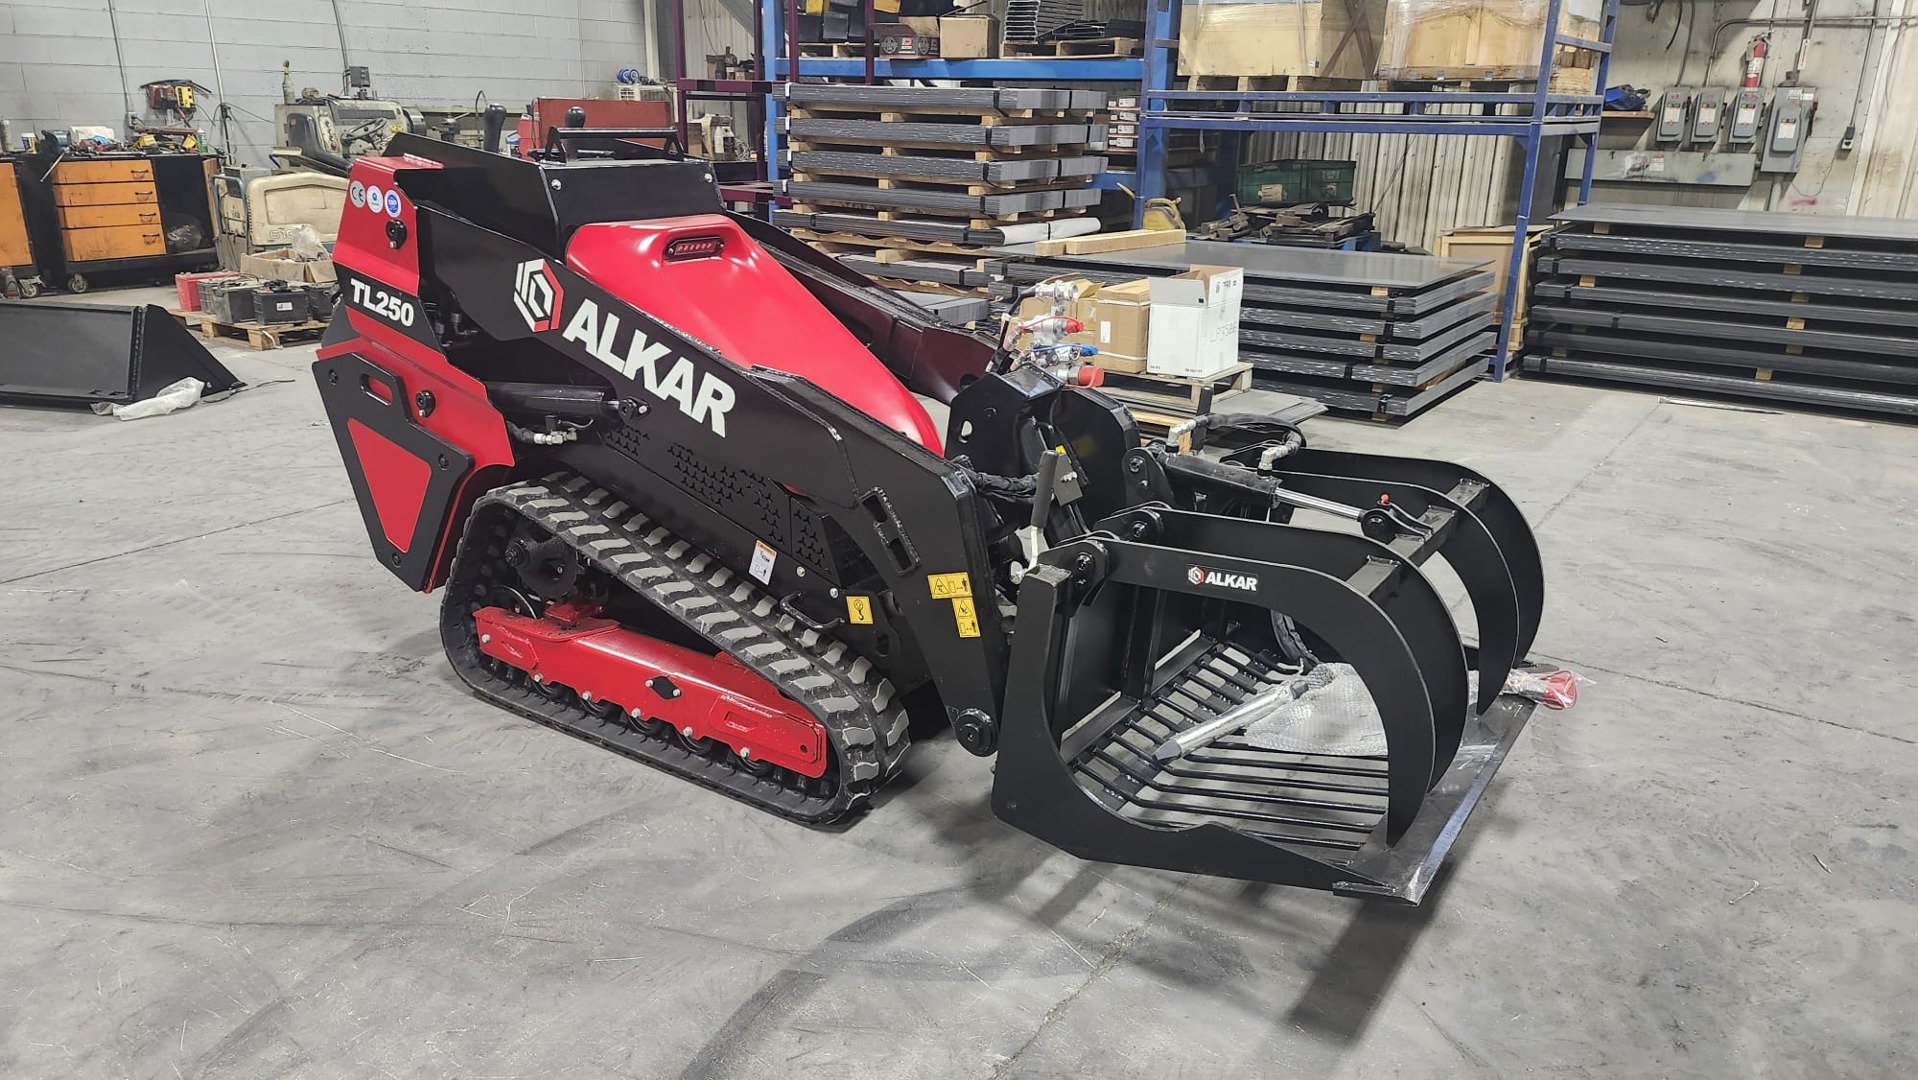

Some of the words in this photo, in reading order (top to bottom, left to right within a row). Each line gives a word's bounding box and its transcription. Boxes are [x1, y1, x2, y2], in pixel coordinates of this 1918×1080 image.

[350, 278, 414, 327] TL250
[562, 298, 736, 438] ALKAR
[1205, 571, 1258, 592] ALKAR
